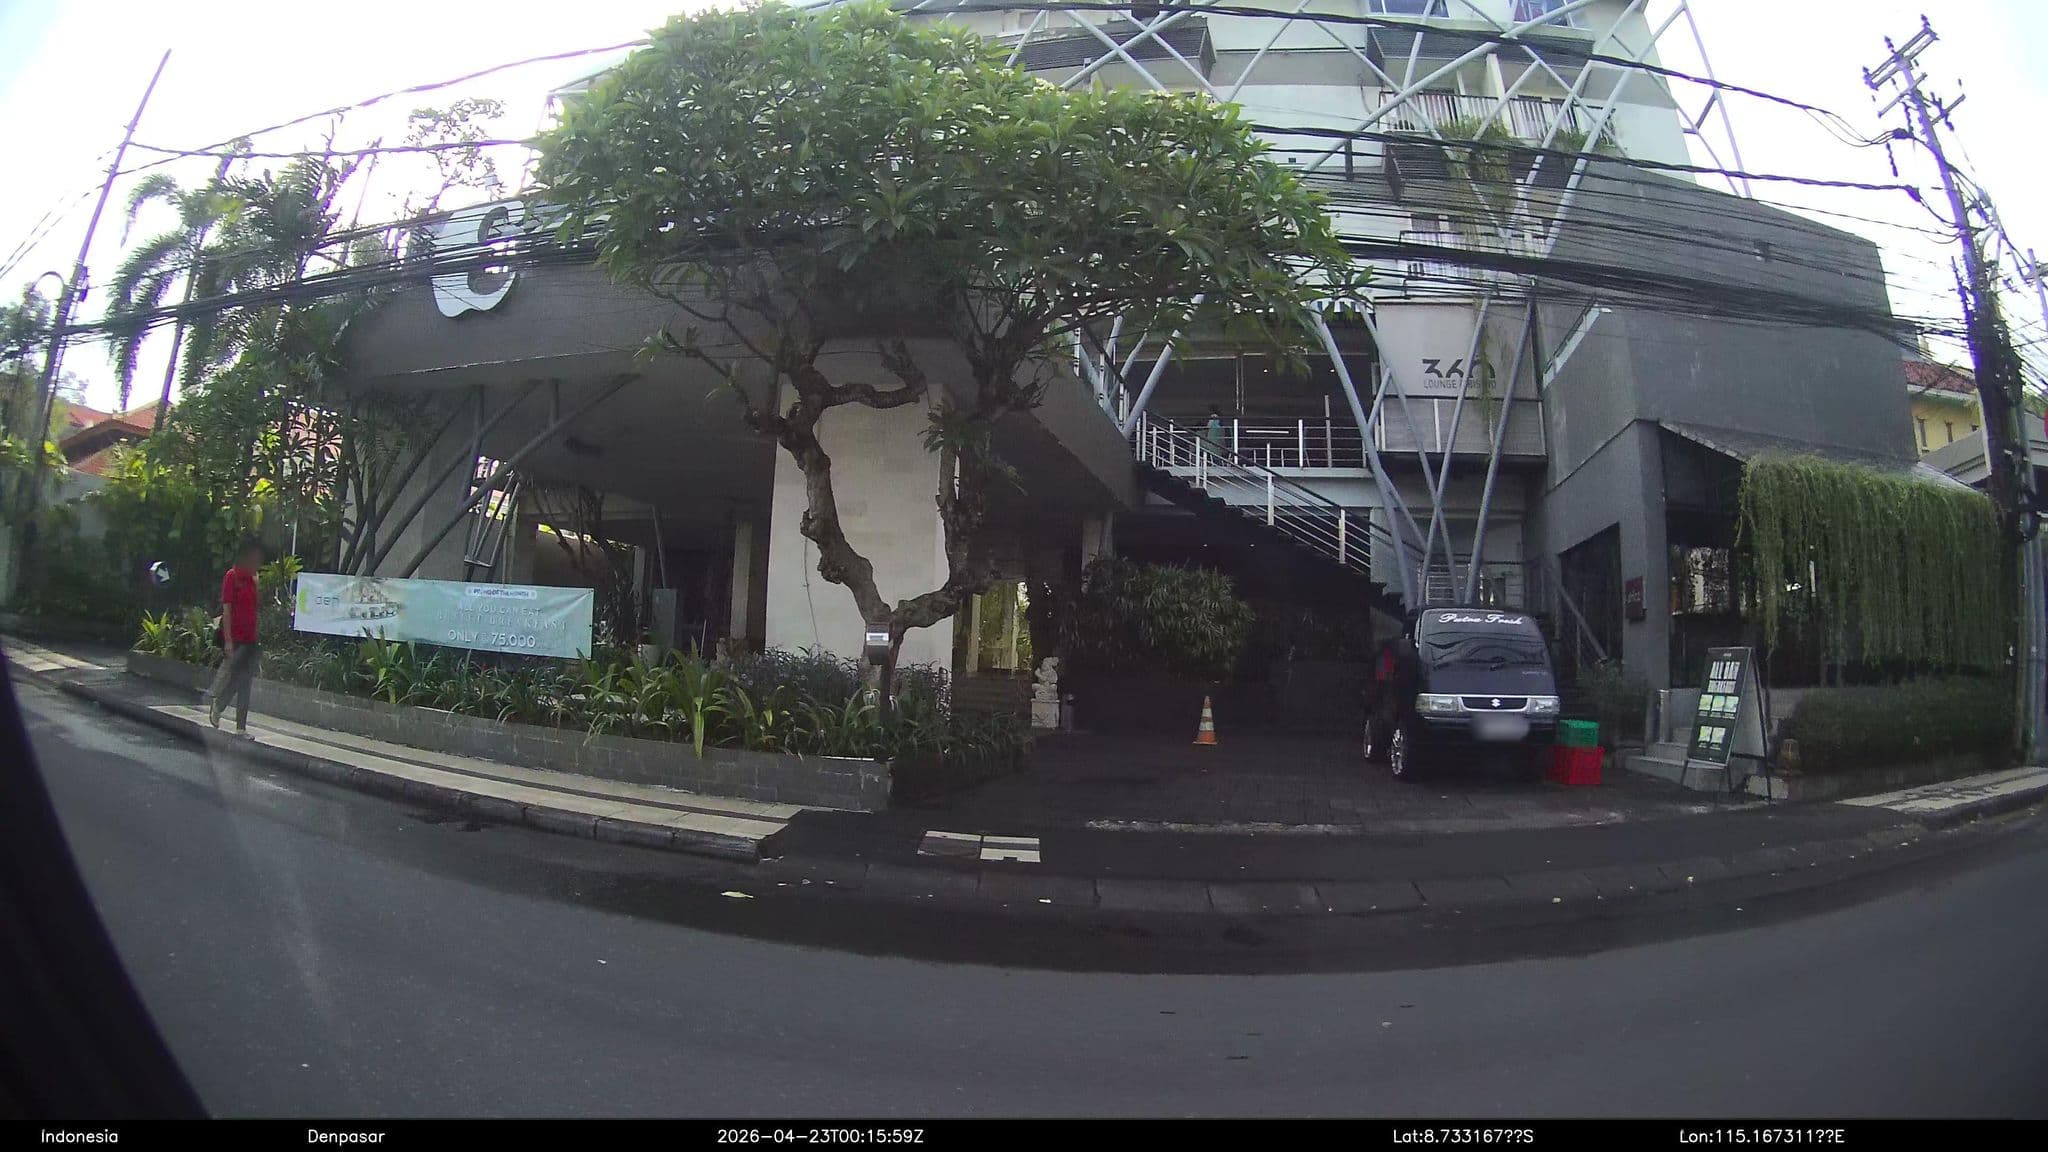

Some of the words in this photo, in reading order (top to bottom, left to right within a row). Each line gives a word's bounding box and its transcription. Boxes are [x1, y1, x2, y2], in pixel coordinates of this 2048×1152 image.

[1423, 379, 1458, 389] LOUNGE
[447, 629, 479, 643] ONLY
[490, 632, 537, 648] 75.000
